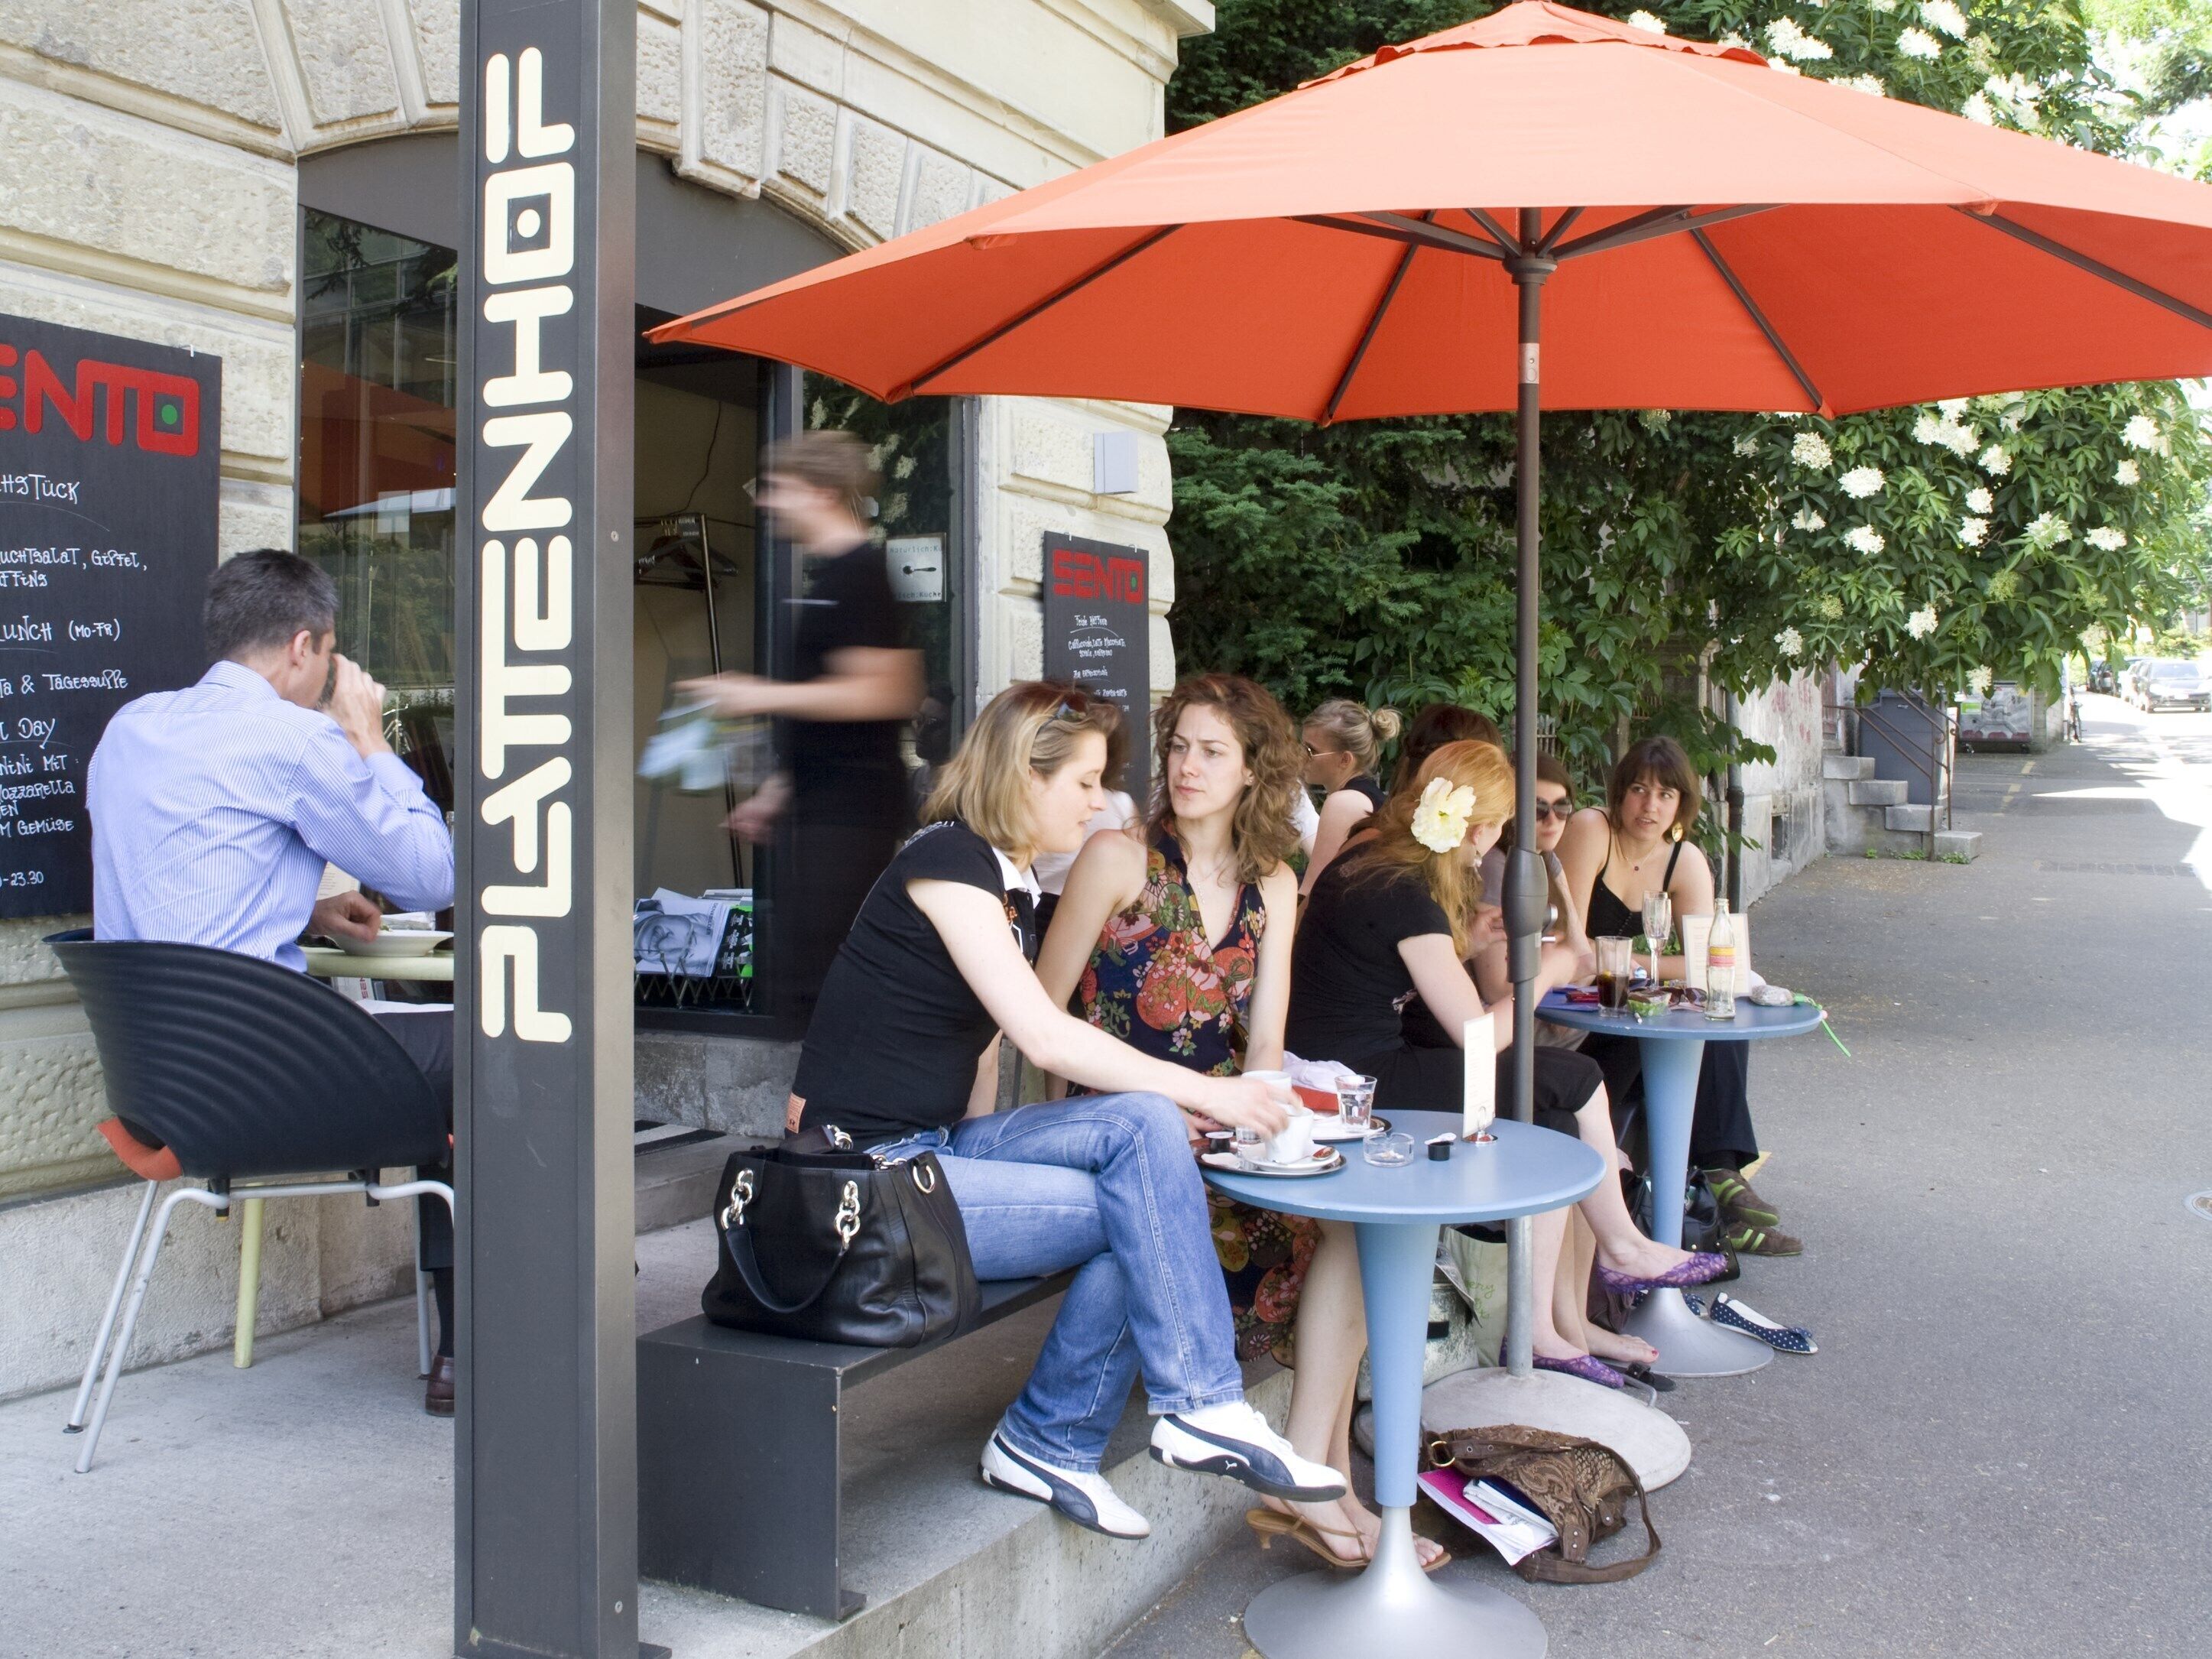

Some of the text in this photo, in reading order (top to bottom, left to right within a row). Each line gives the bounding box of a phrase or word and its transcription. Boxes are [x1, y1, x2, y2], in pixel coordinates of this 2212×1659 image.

[0, 343, 200, 458] NTO
[481, 47, 575, 1044] PLATTENHOF
[1052, 549, 1144, 604] SENTO
[21, 674, 35, 695] &
[18, 717, 56, 750] Day
